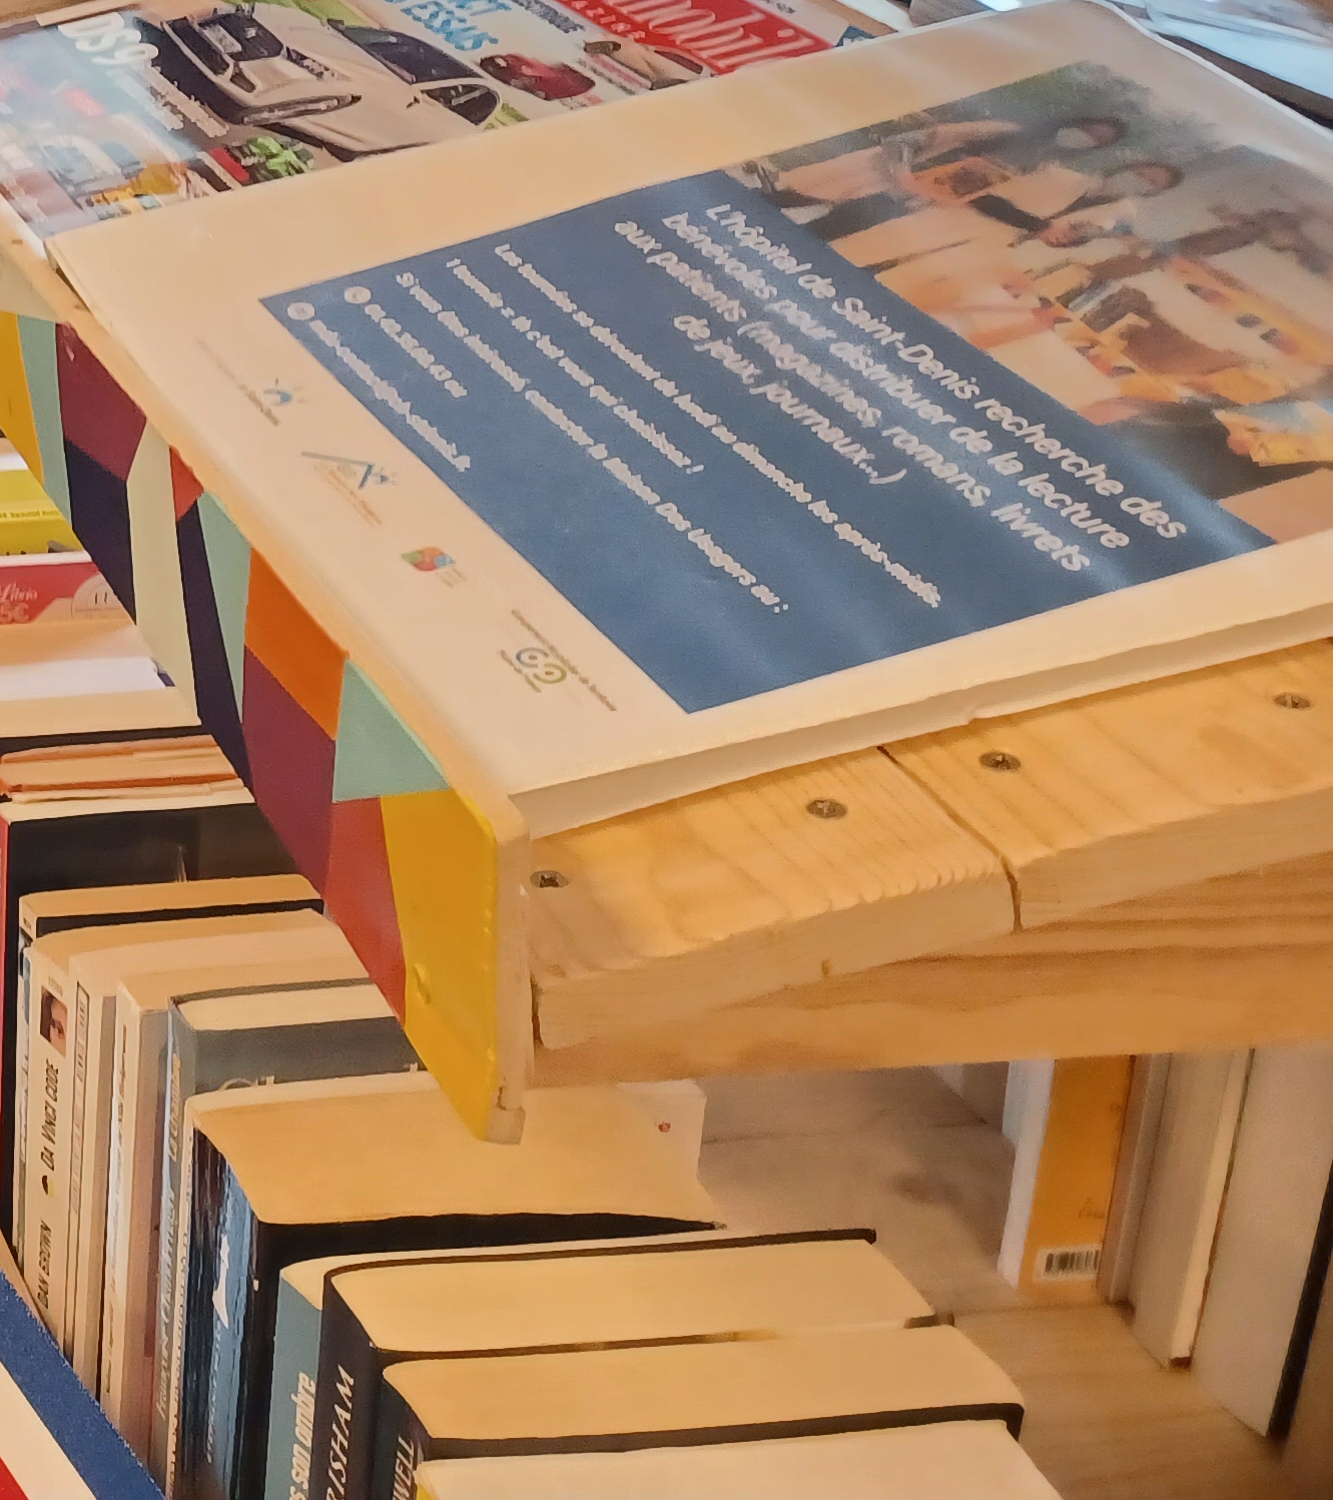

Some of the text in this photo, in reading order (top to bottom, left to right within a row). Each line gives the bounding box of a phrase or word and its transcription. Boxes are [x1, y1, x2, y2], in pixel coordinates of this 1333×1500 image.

[614, 220, 1091, 571] aux patients (magazines, romans, livrets
[662, 212, 1129, 548] bénévoles pour distribuer de la lecture
[673, 314, 710, 340] de
[749, 380, 906, 484] journaux...)
[705, 204, 1186, 538] L'hôpital de Saint-Denis recherche des
[44, 1057, 61, 1100] CODE
[290, 1371, 316, 1448] ombre
[290, 1444, 311, 1489] son
